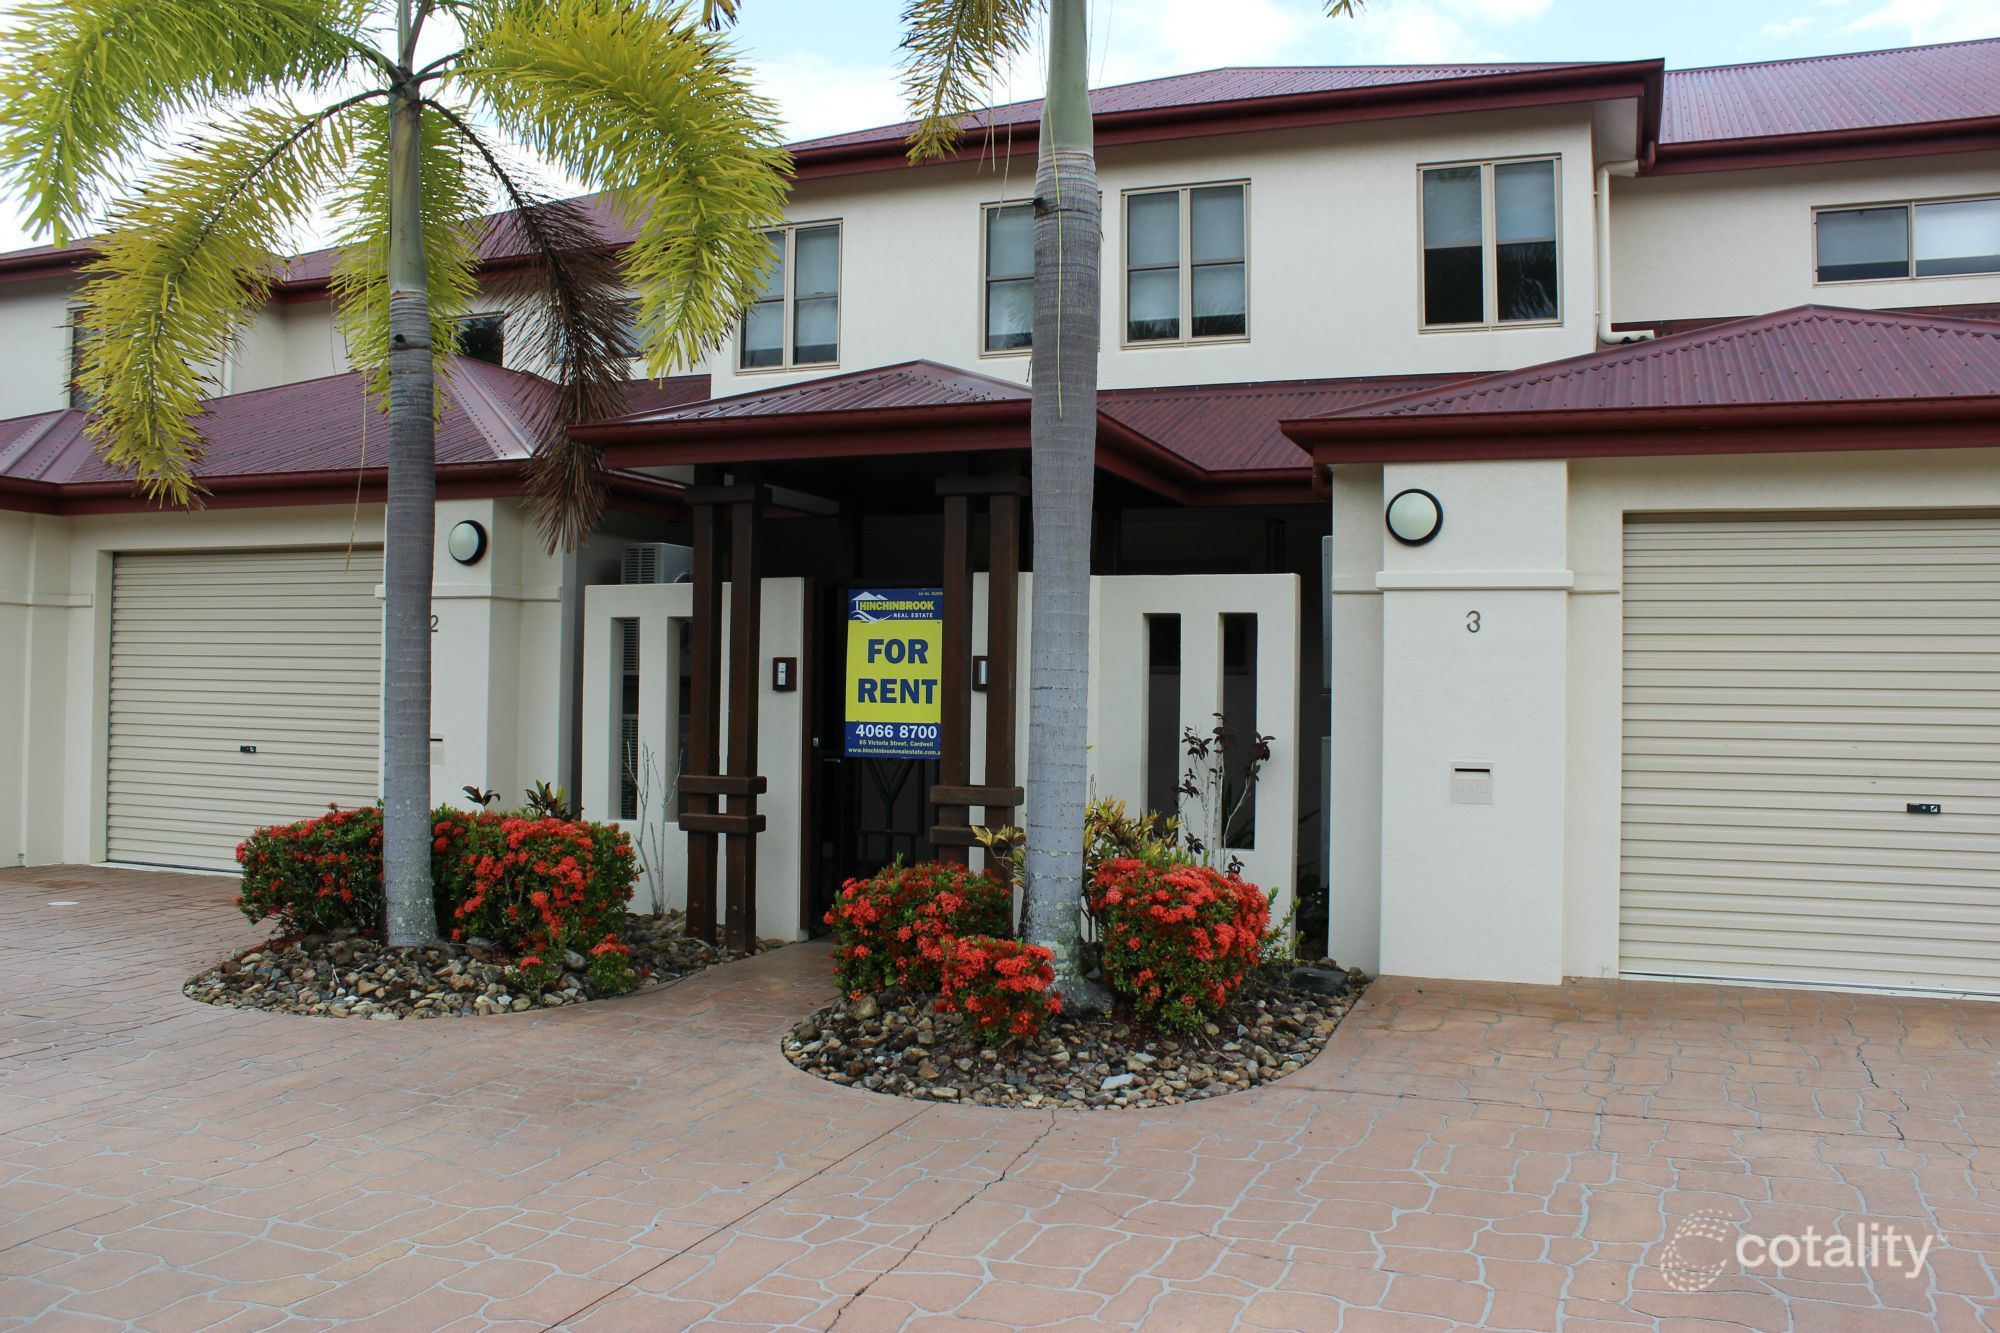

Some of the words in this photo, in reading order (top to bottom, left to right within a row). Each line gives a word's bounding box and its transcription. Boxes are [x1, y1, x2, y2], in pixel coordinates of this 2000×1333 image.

[860, 601, 935, 610] HINCHINBROOK
[1466, 610, 1480, 633] 3
[867, 638, 929, 665] FOR
[857, 678, 938, 705] RENT
[855, 724, 894, 738] 4066
[899, 725, 937, 739] 8700
